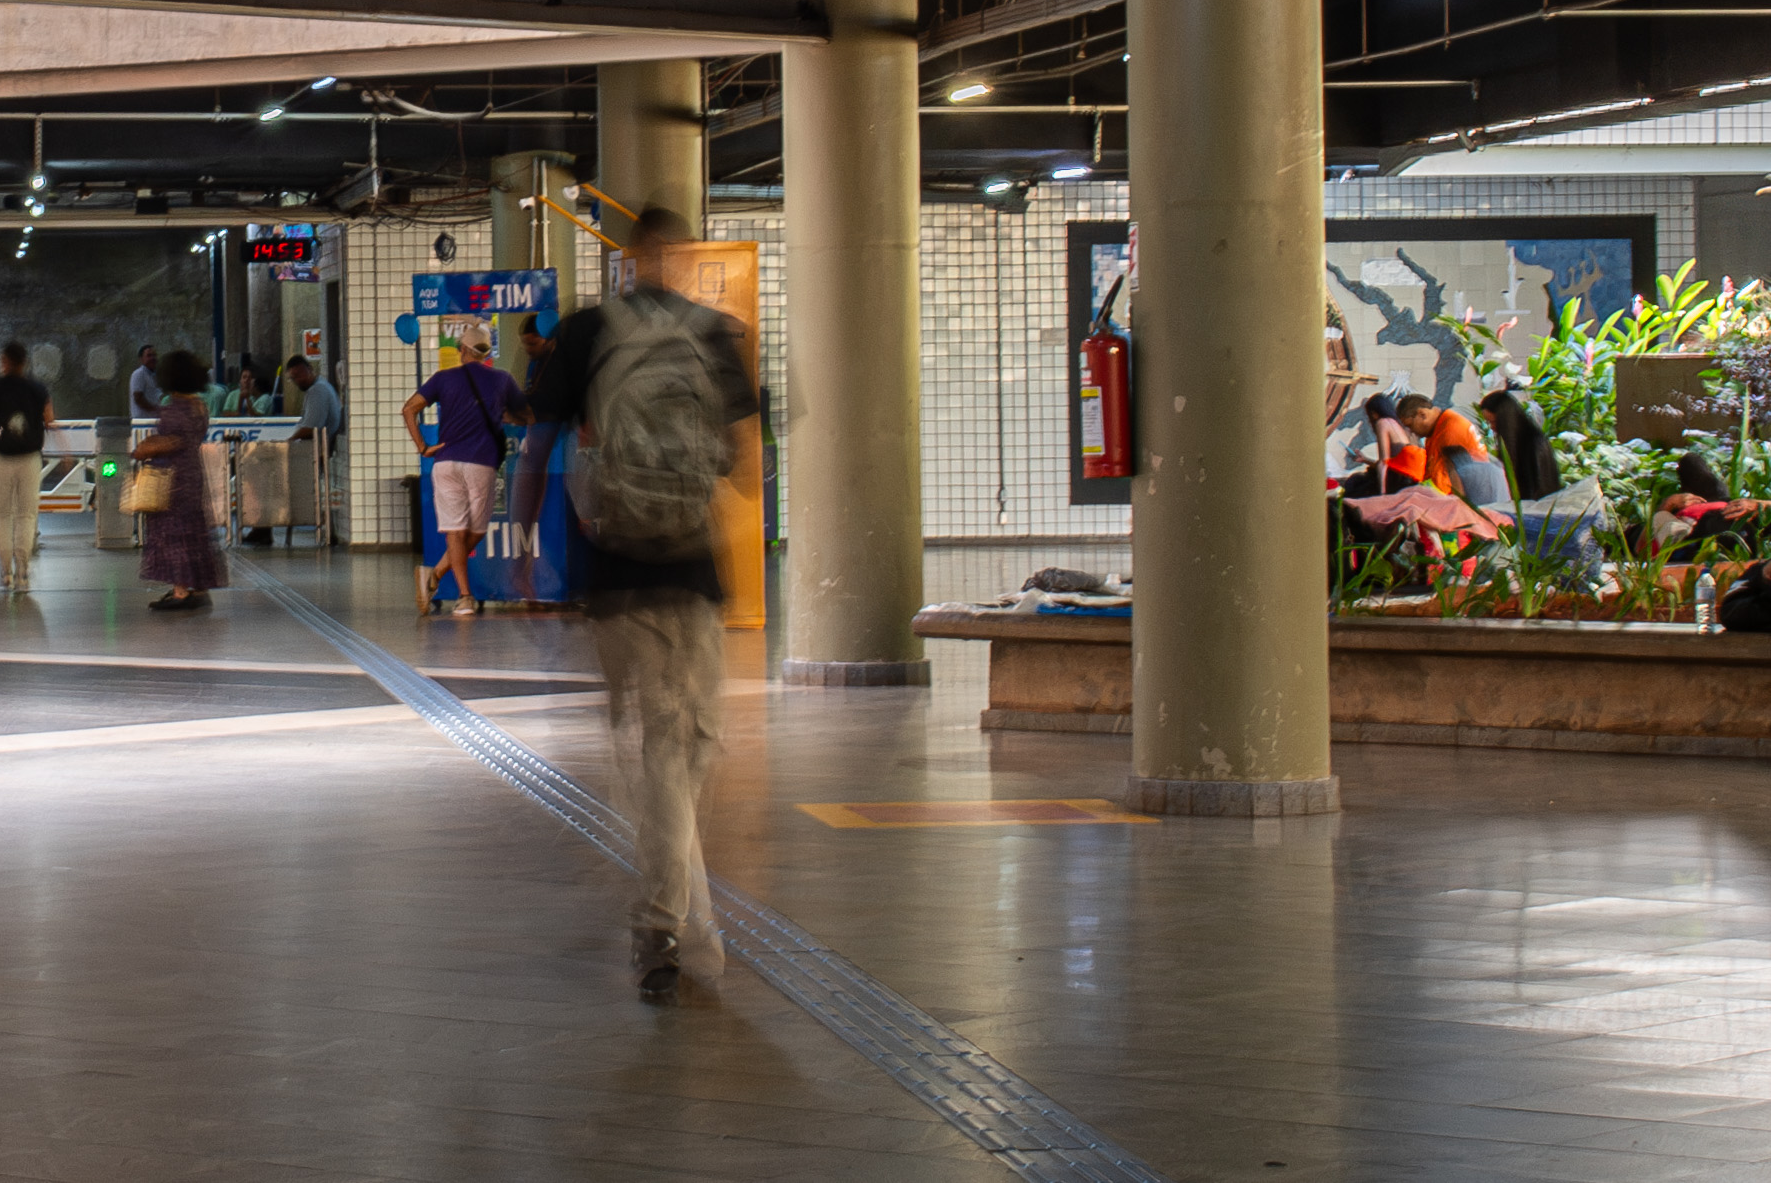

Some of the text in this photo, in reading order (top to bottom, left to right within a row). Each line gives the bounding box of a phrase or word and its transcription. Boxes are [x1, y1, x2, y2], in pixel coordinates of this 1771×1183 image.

[419, 288, 439, 299] AQUI
[492, 283, 532, 309] TIM
[421, 299, 438, 309] TEM
[486, 522, 540, 559] TIM
